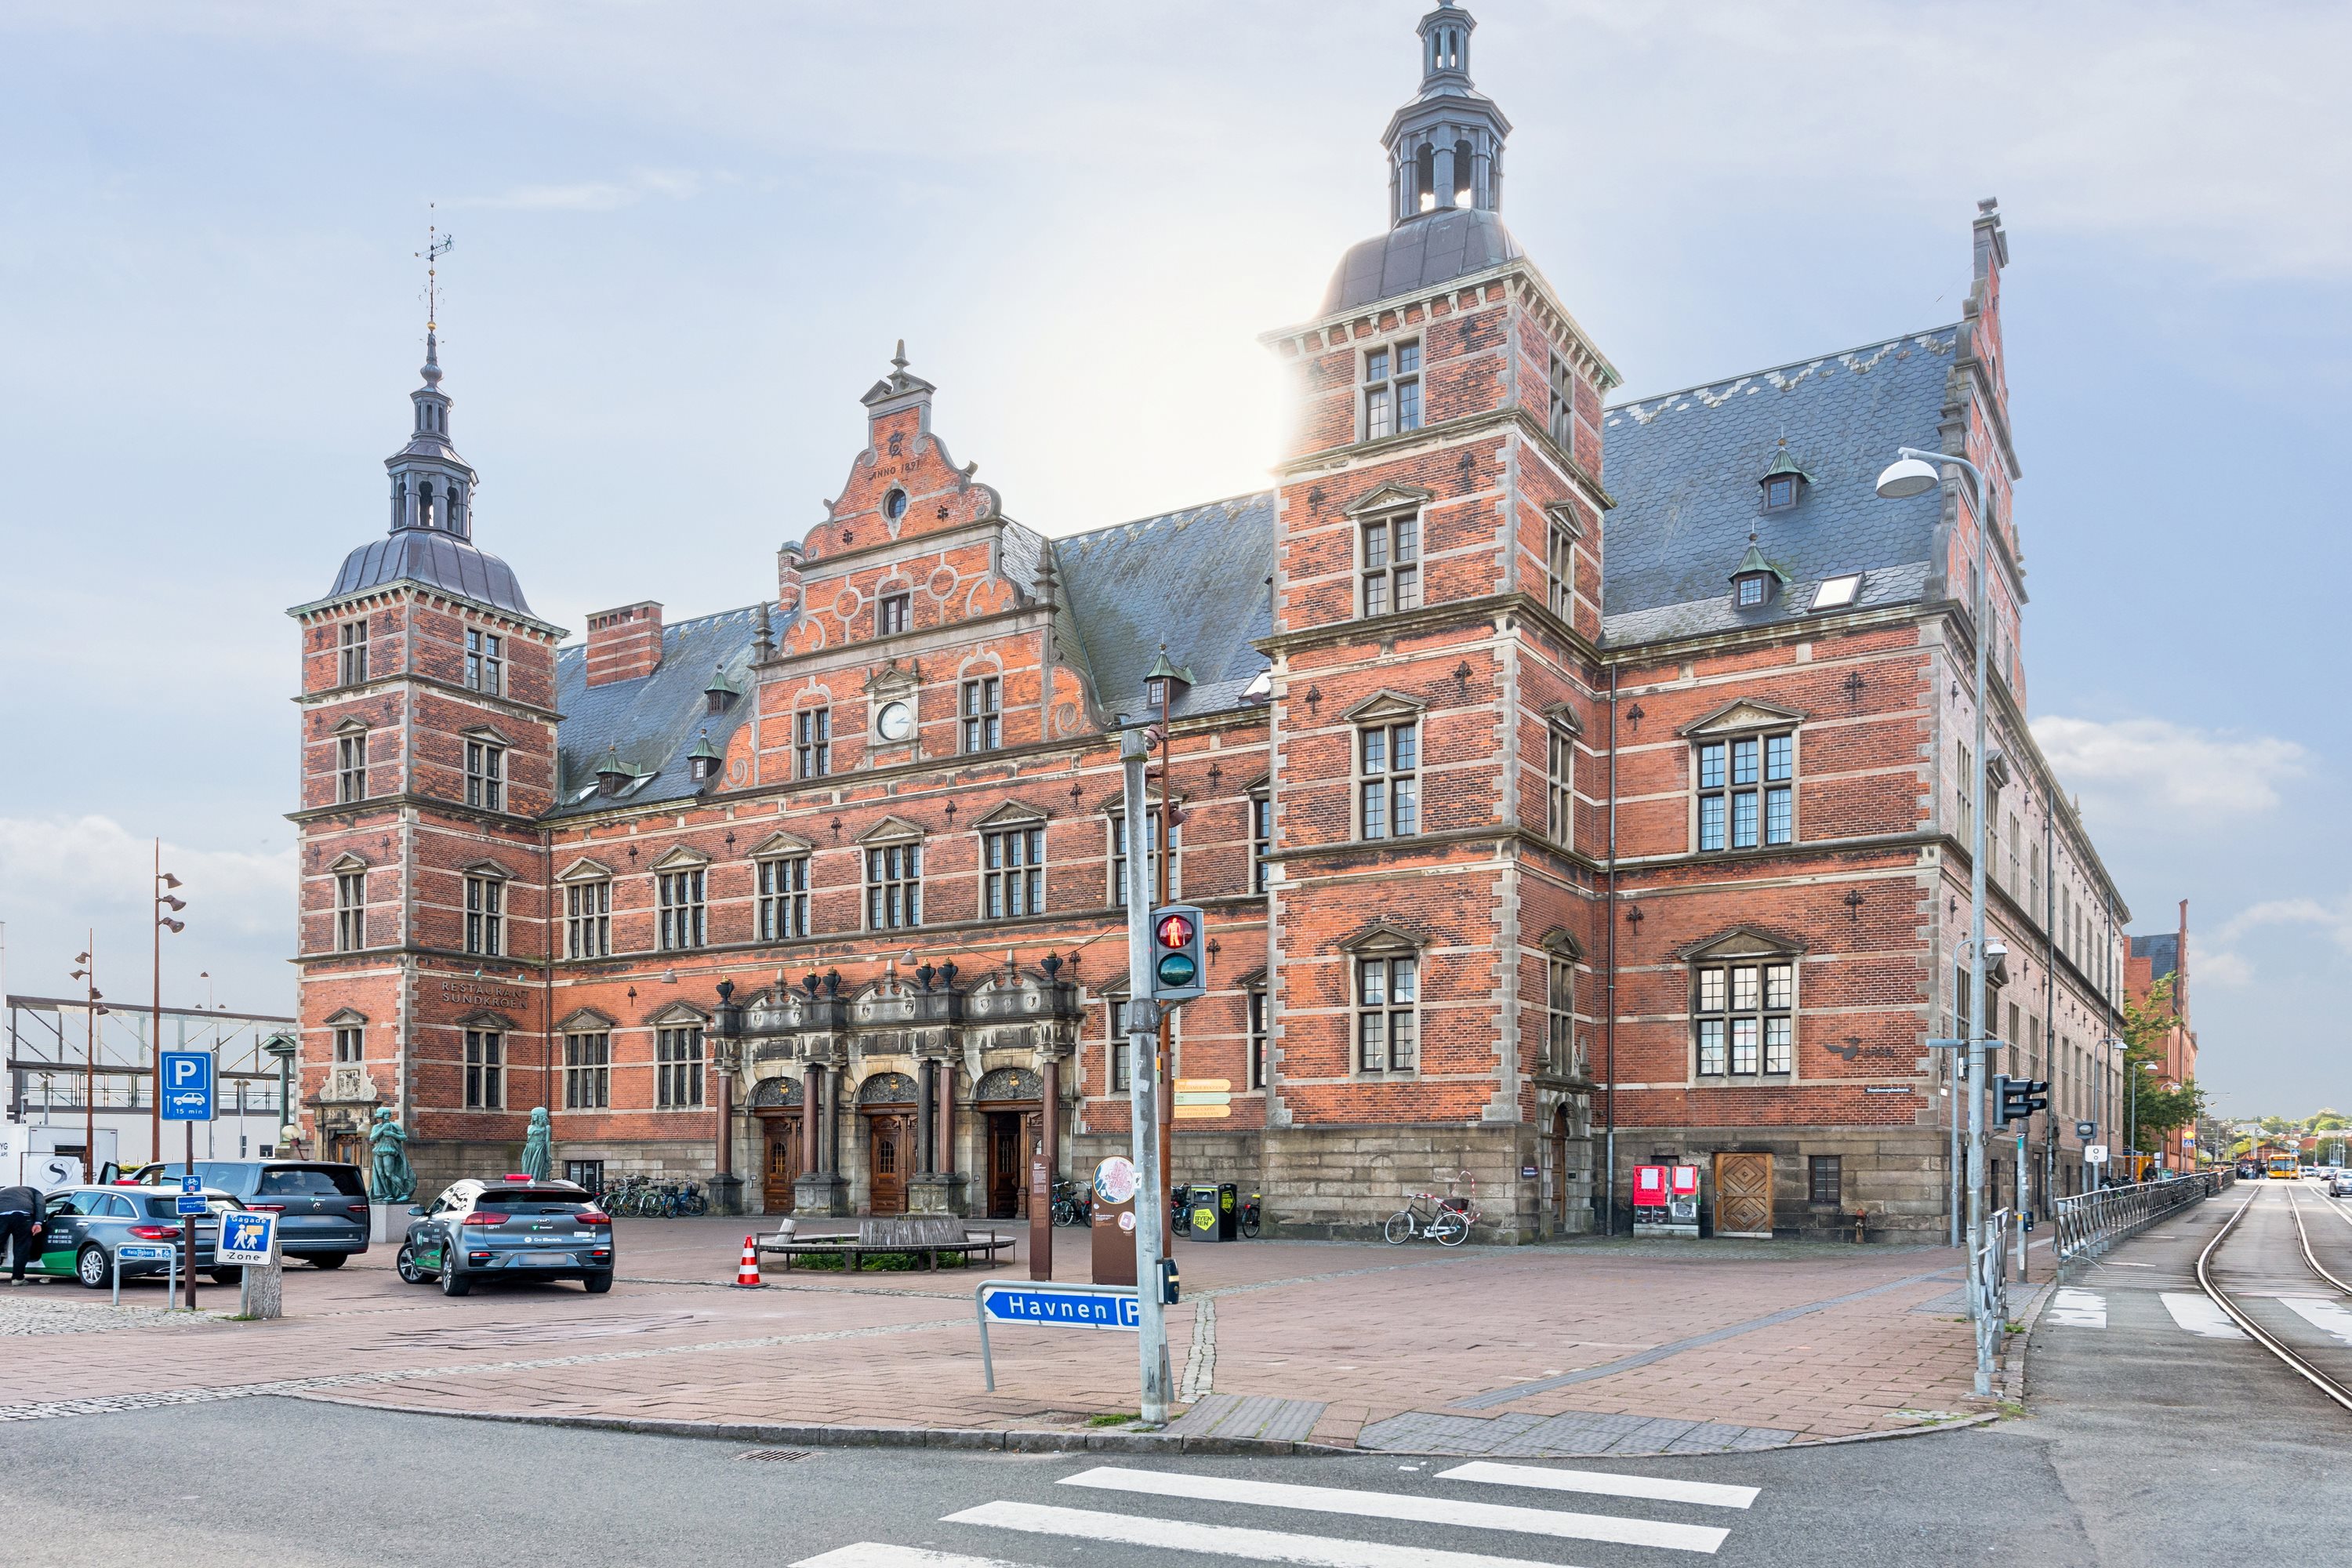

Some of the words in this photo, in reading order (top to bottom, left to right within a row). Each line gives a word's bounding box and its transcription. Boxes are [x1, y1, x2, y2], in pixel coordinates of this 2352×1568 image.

[869, 466, 896, 481] ANNO
[441, 981, 528, 998] RESTAURANT
[442, 993, 528, 1009] SUNDKROEN
[175, 1060, 197, 1086] P
[228, 1252, 260, 1261] Zone
[1008, 1295, 1107, 1319] Havnen
